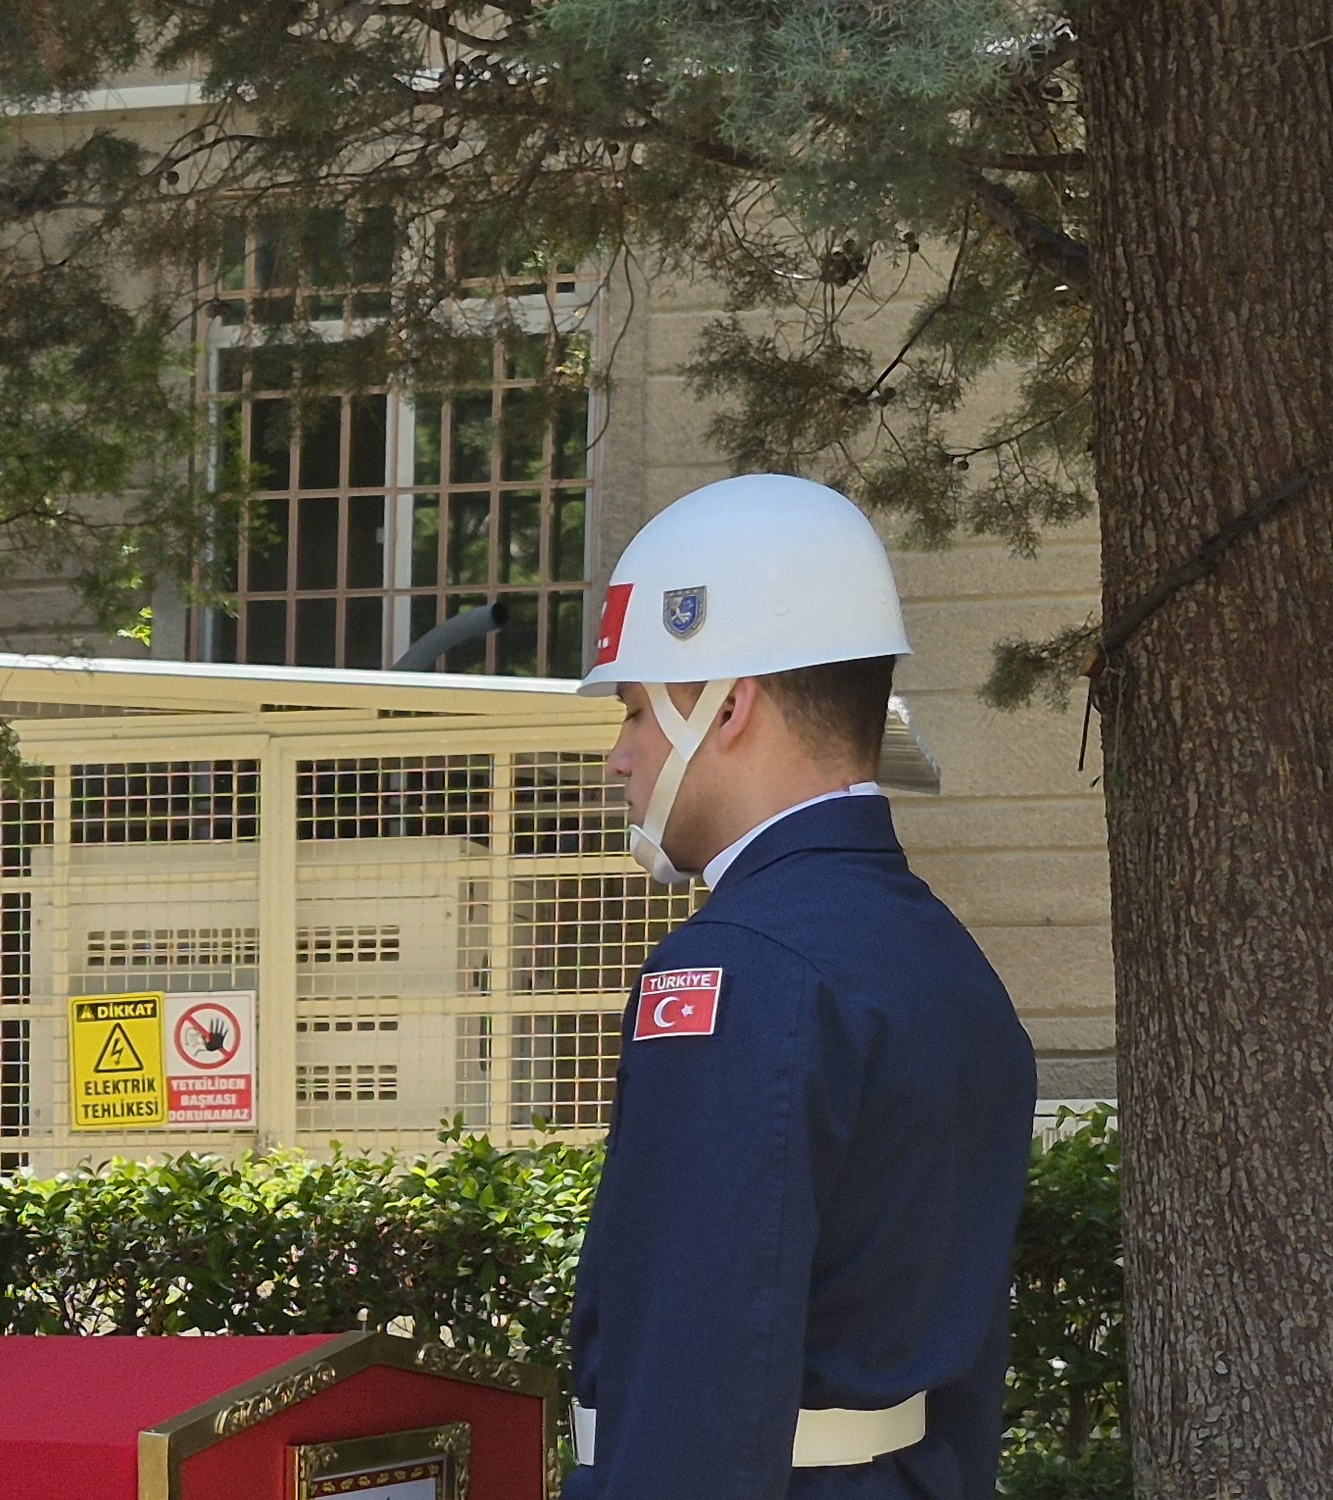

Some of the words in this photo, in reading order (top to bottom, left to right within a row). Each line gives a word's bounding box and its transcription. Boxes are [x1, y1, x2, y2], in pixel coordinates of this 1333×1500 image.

[649, 972, 712, 990] TÜRKİYE
[97, 1003, 154, 1019] DİKKAT
[84, 1074, 157, 1095] ELEKTRİK
[82, 1097, 158, 1119] TEHLİKESİ
